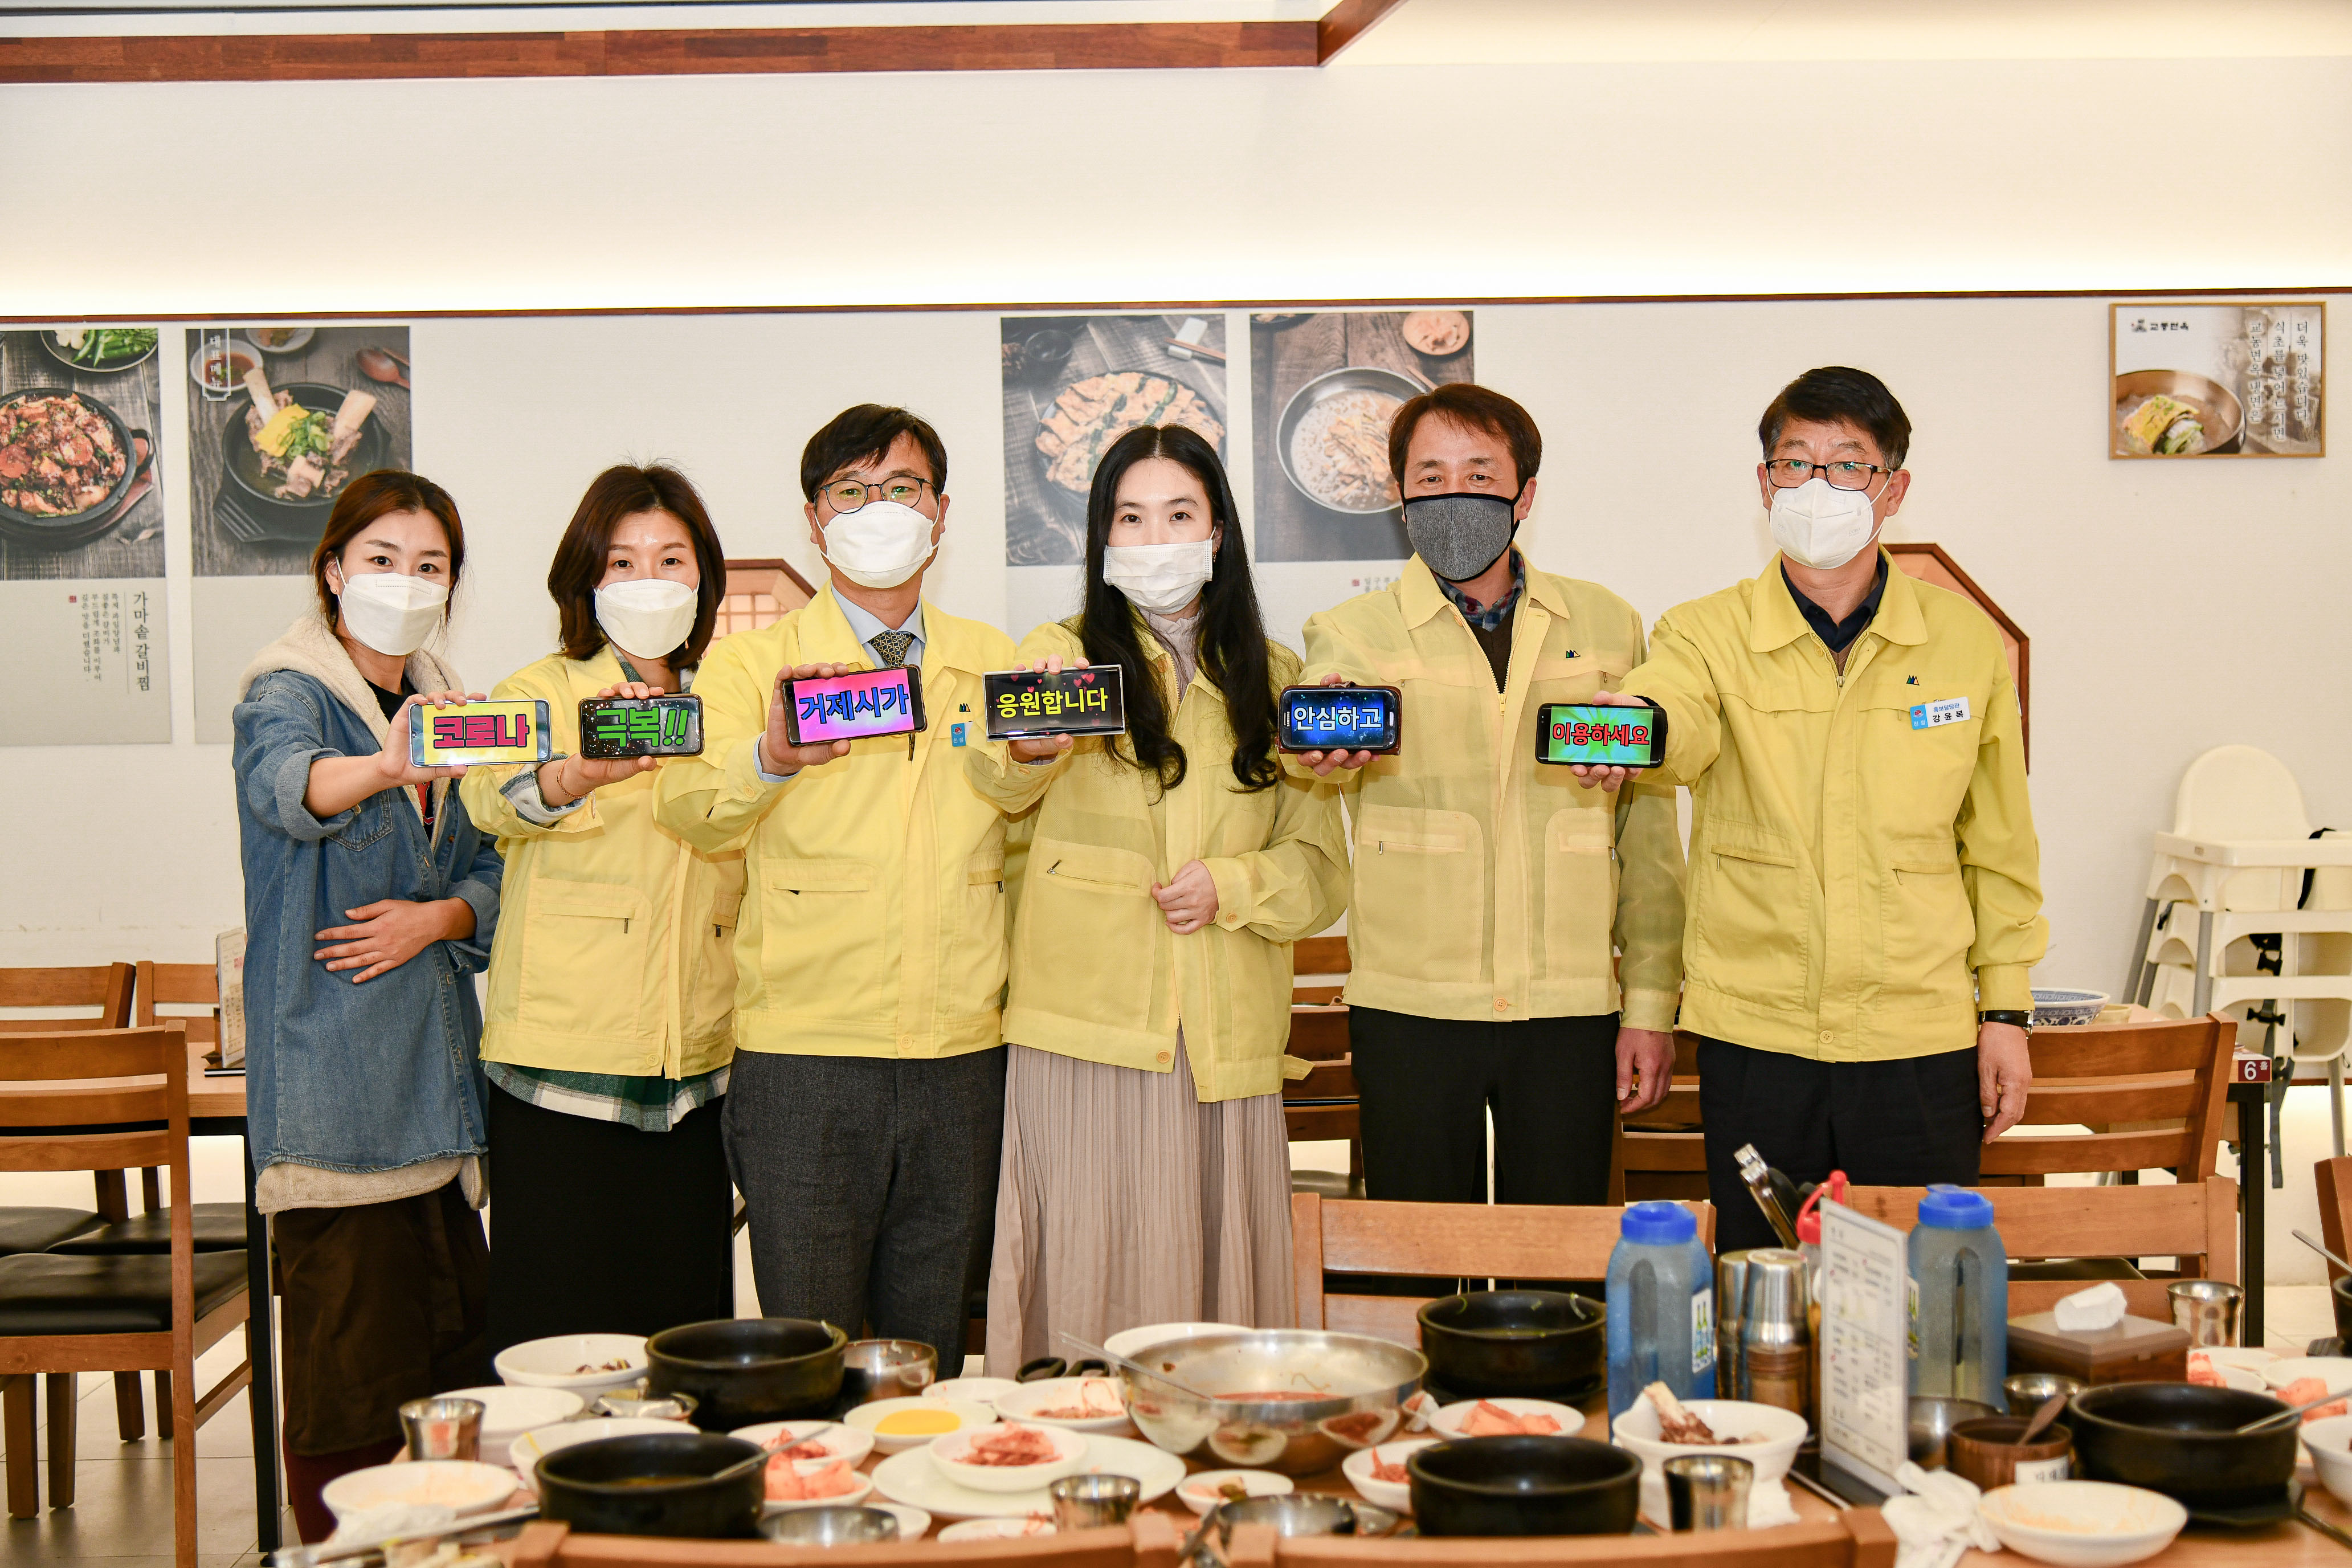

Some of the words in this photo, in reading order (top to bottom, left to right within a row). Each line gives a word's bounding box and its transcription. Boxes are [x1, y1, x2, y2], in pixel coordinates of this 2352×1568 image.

[2250, 321, 2262, 377] 교동면옥
[2273, 320, 2285, 363] 식초를
[2297, 320, 2308, 349] 더욱
[2248, 381, 2261, 422] 냉면은
[2297, 353, 2309, 422] 맛있습니다
[798, 684, 909, 724] 거제시가
[996, 687, 1108, 718] 응원합니다
[1293, 706, 1383, 732] 안심하고
[434, 713, 530, 749] 코로나
[595, 707, 689, 747] 극복!!
[1552, 722, 1649, 746] 이용하세요
[2244, 1061, 2257, 1080] 6
